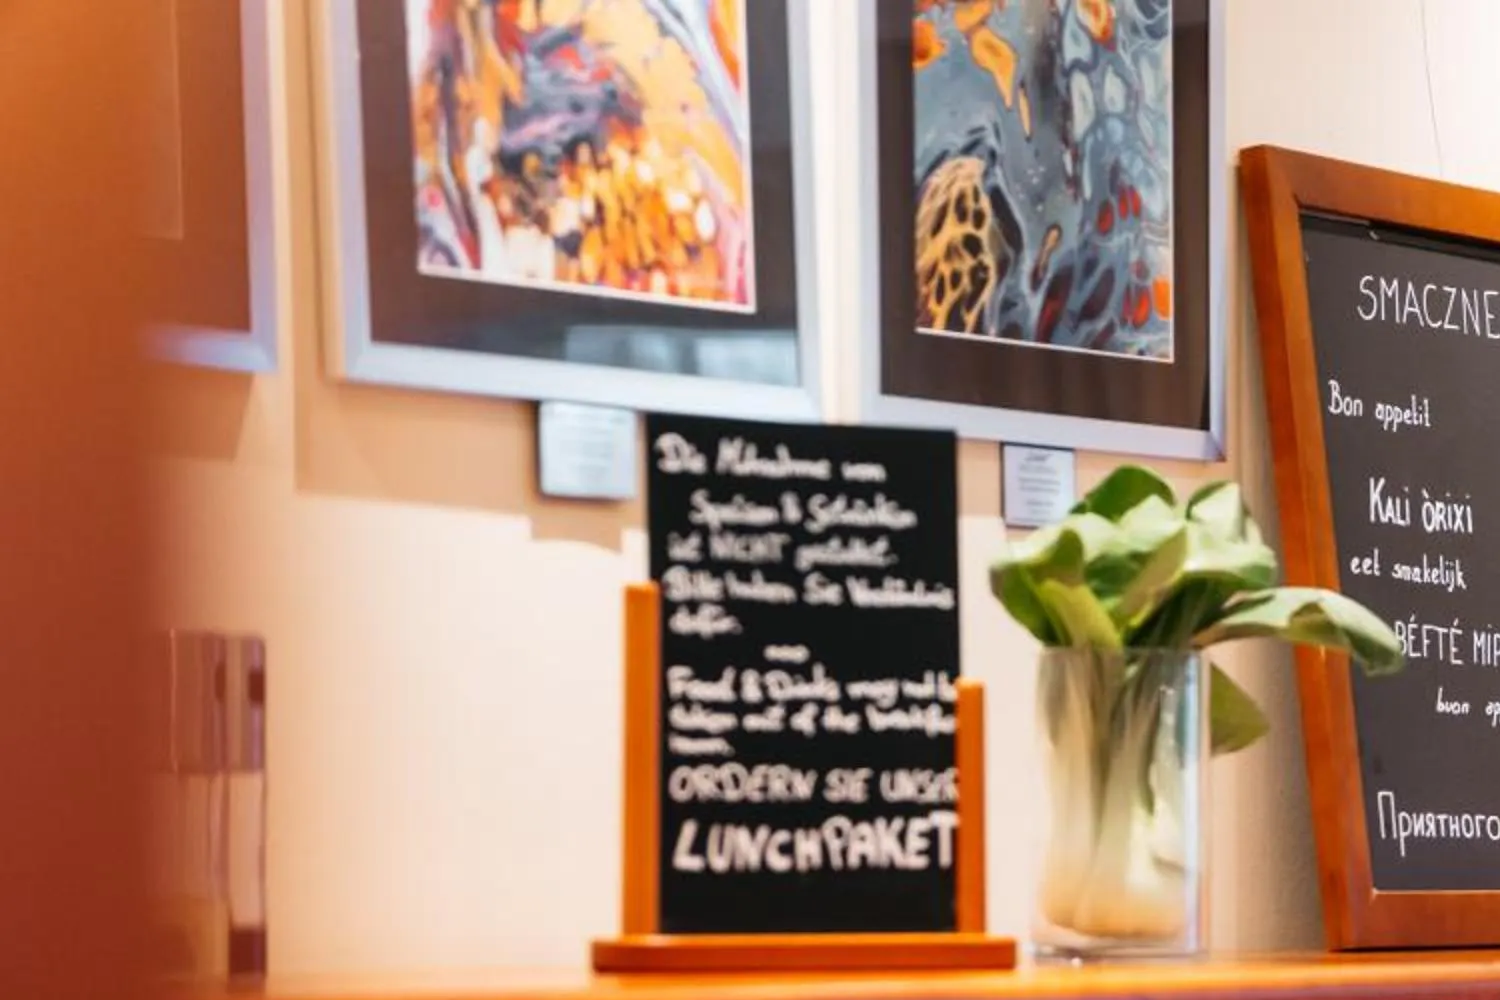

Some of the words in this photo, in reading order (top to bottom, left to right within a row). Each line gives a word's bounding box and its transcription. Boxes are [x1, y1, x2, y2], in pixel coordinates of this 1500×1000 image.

[1328, 379, 1363, 416] Bon
[1375, 394, 1431, 433] appetit
[1391, 553, 1467, 592] smakelijk
[1436, 686, 1470, 714] buon
[668, 761, 818, 804] ORDERN
[672, 809, 961, 874] LUNCHPAKET
